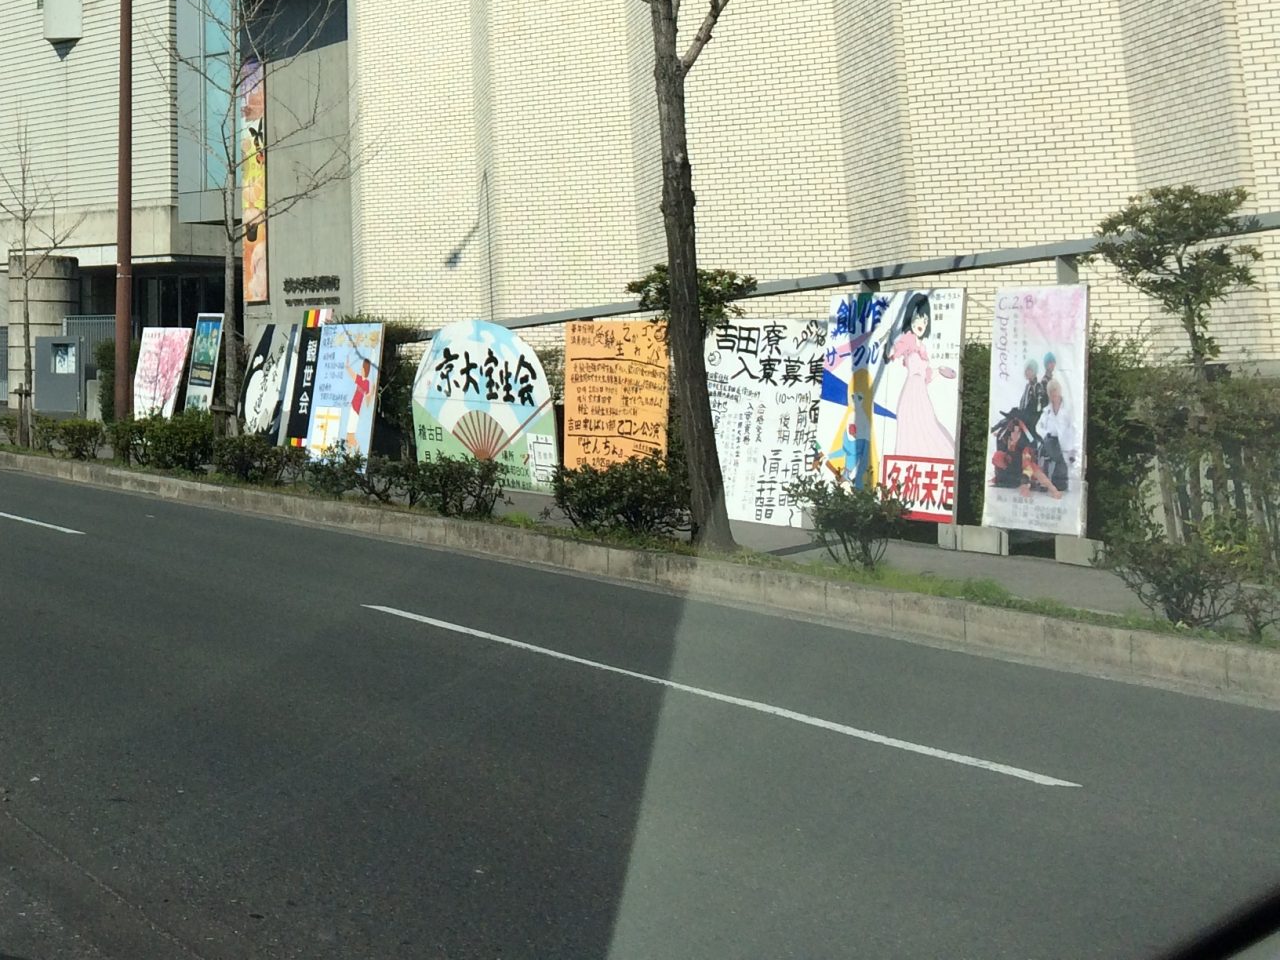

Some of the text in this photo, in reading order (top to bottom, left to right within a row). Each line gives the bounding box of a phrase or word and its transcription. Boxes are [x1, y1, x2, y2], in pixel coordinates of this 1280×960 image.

[836, 298, 883, 336] 創作
[716, 321, 788, 357] 吉田寮
[825, 341, 881, 367] サークル
[996, 315, 1010, 382] project
[435, 347, 538, 407] 京大宝生会
[731, 353, 825, 387] 入寮募集
[888, 463, 954, 511] 名称未定
